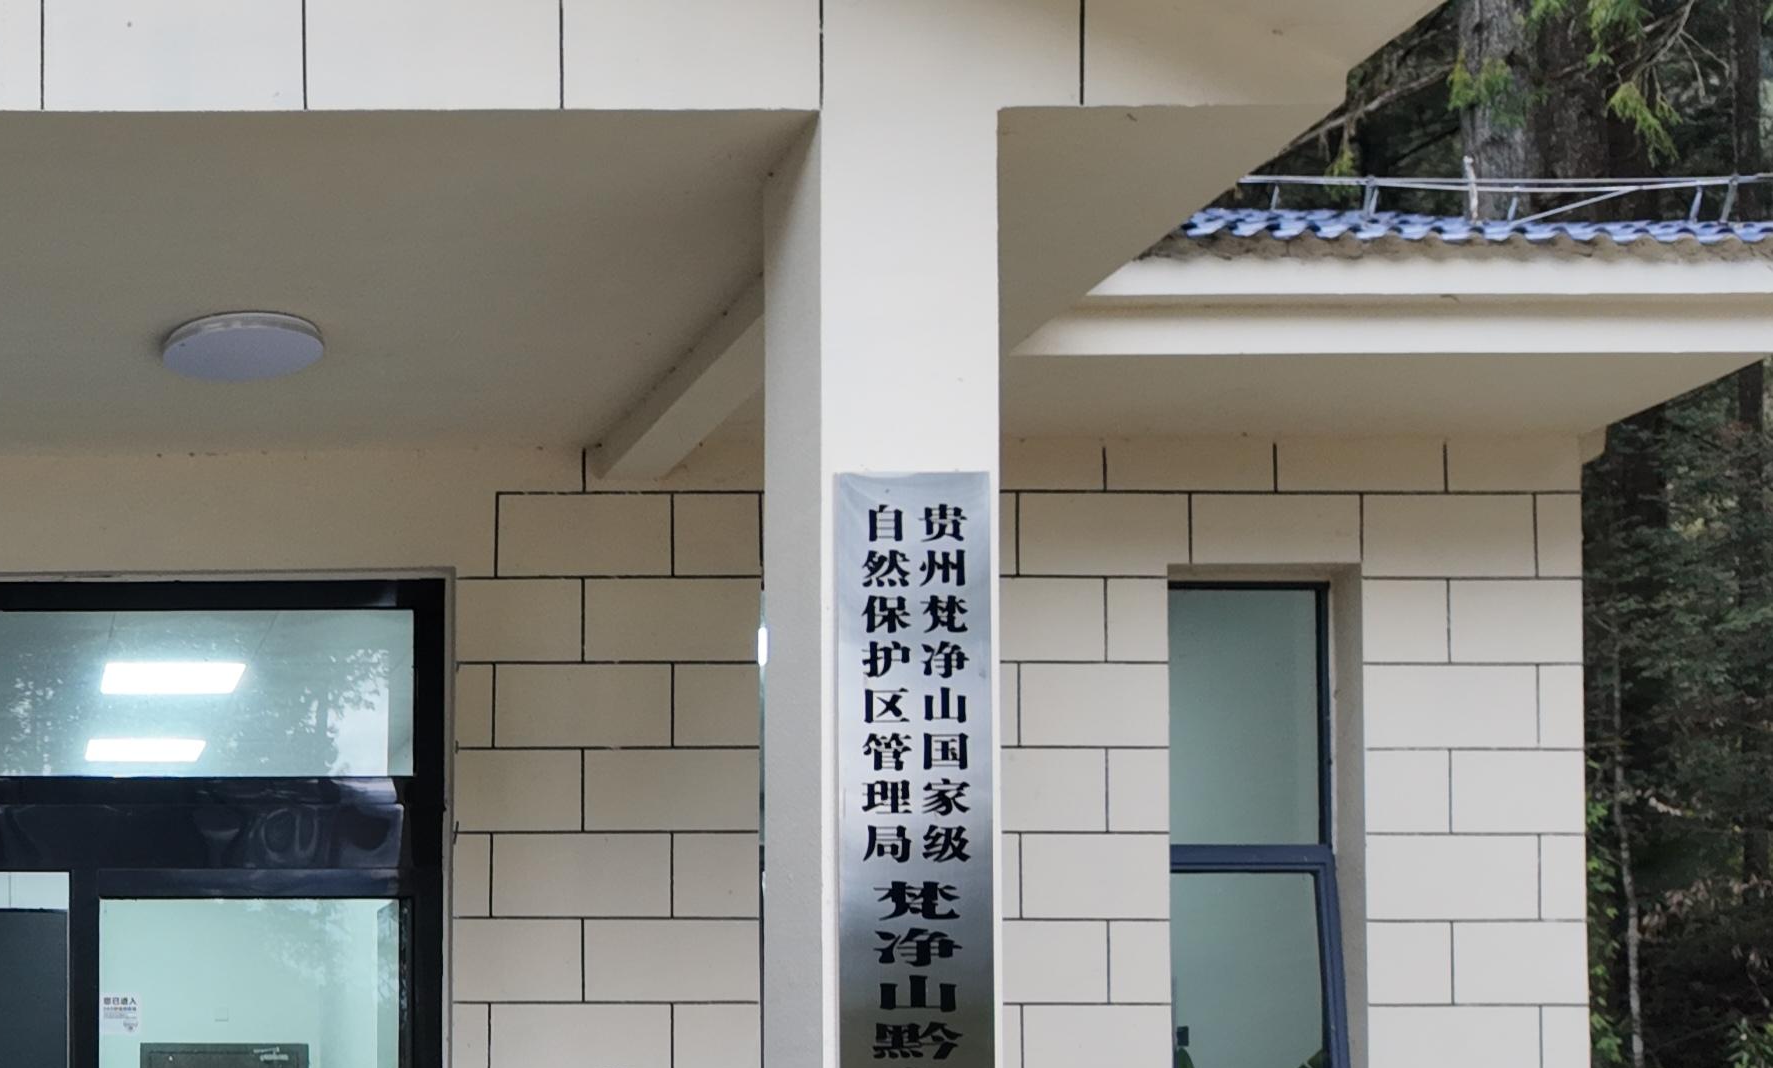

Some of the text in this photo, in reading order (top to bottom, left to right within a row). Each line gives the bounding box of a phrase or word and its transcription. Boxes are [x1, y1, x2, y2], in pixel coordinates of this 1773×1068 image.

[862, 504, 912, 863] 自然保护区管理局
[919, 503, 971, 863] 贵州梵净山国家级
